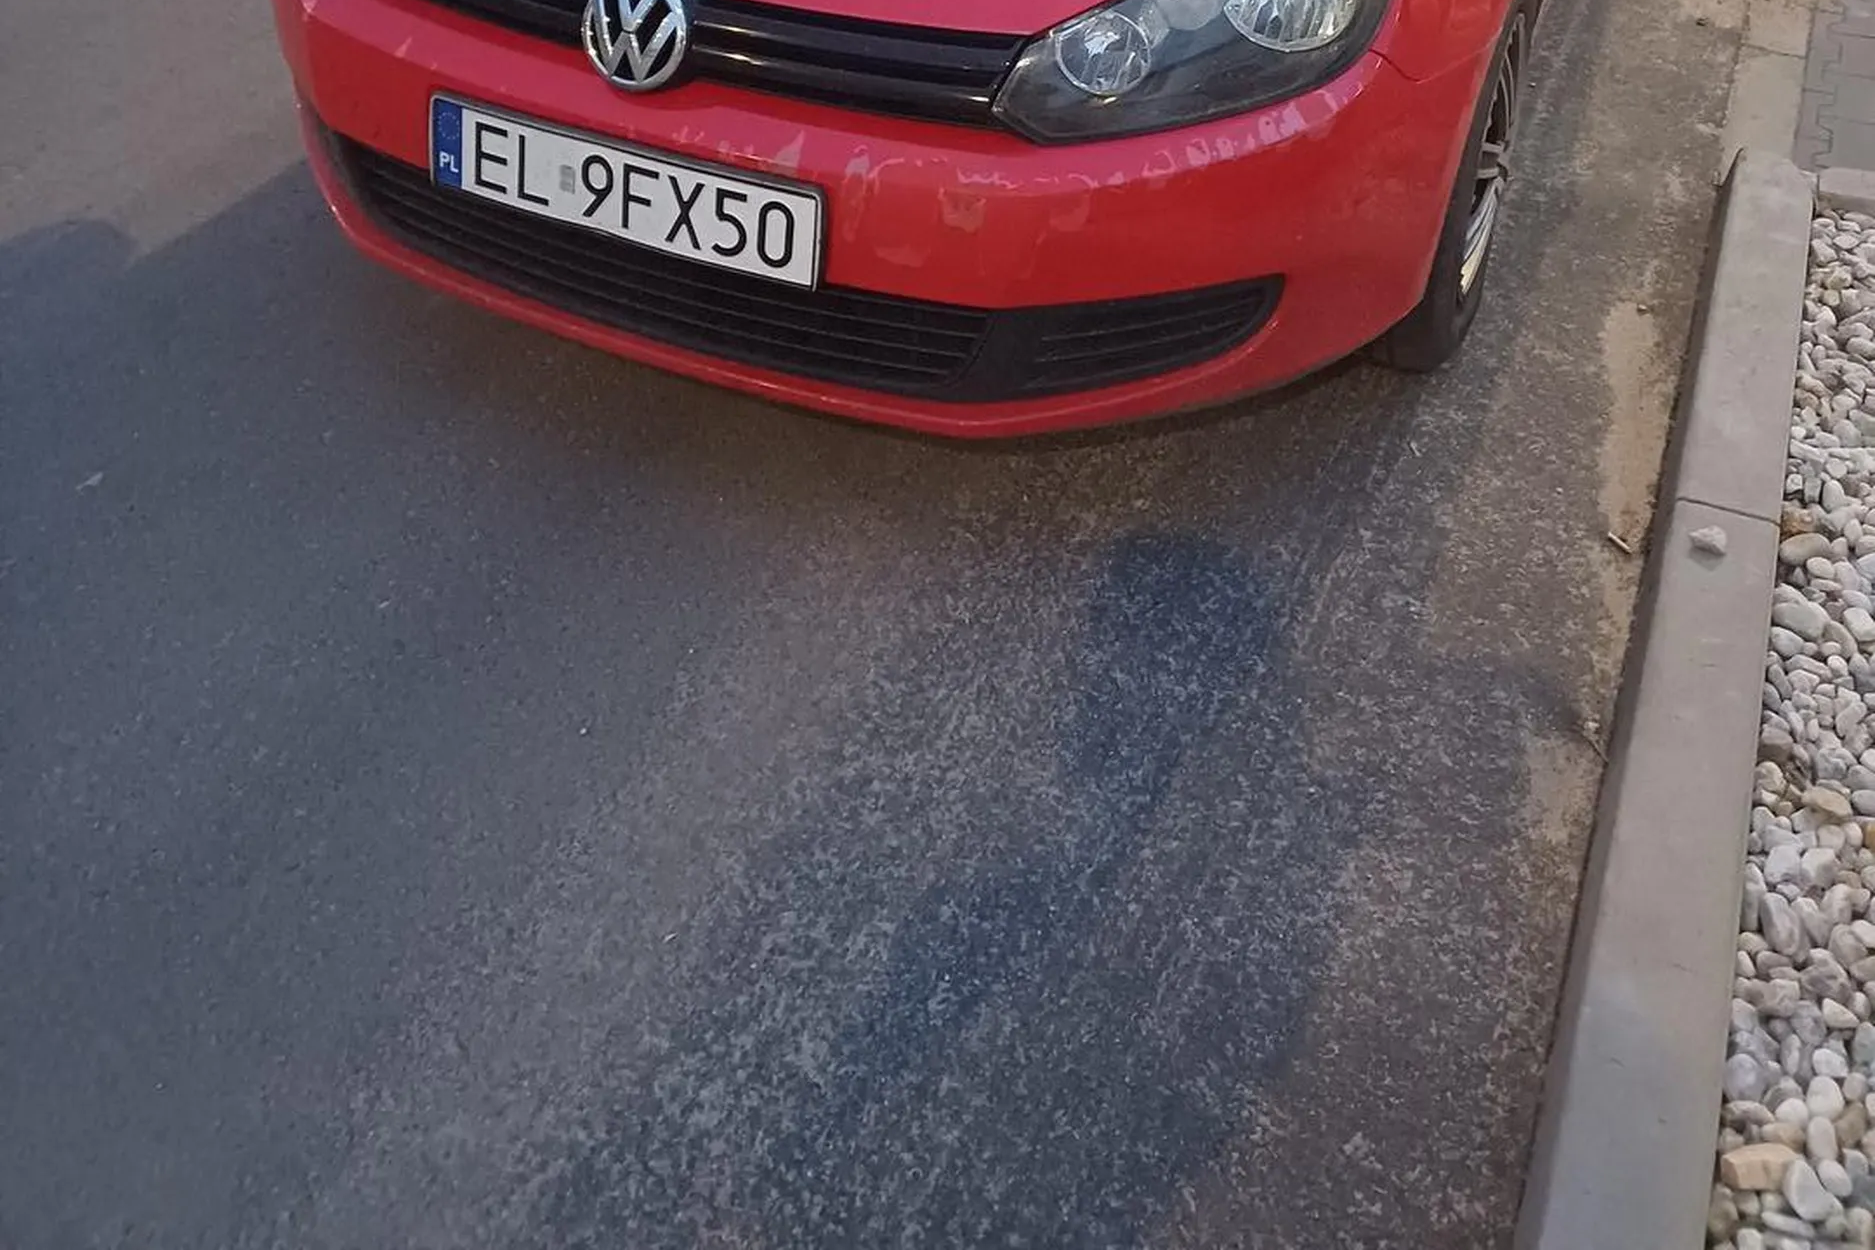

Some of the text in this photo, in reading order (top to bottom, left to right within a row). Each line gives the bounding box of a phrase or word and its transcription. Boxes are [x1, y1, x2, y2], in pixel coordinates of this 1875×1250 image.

[439, 150, 459, 173] PL
[475, 121, 795, 268] EL 9FX50
